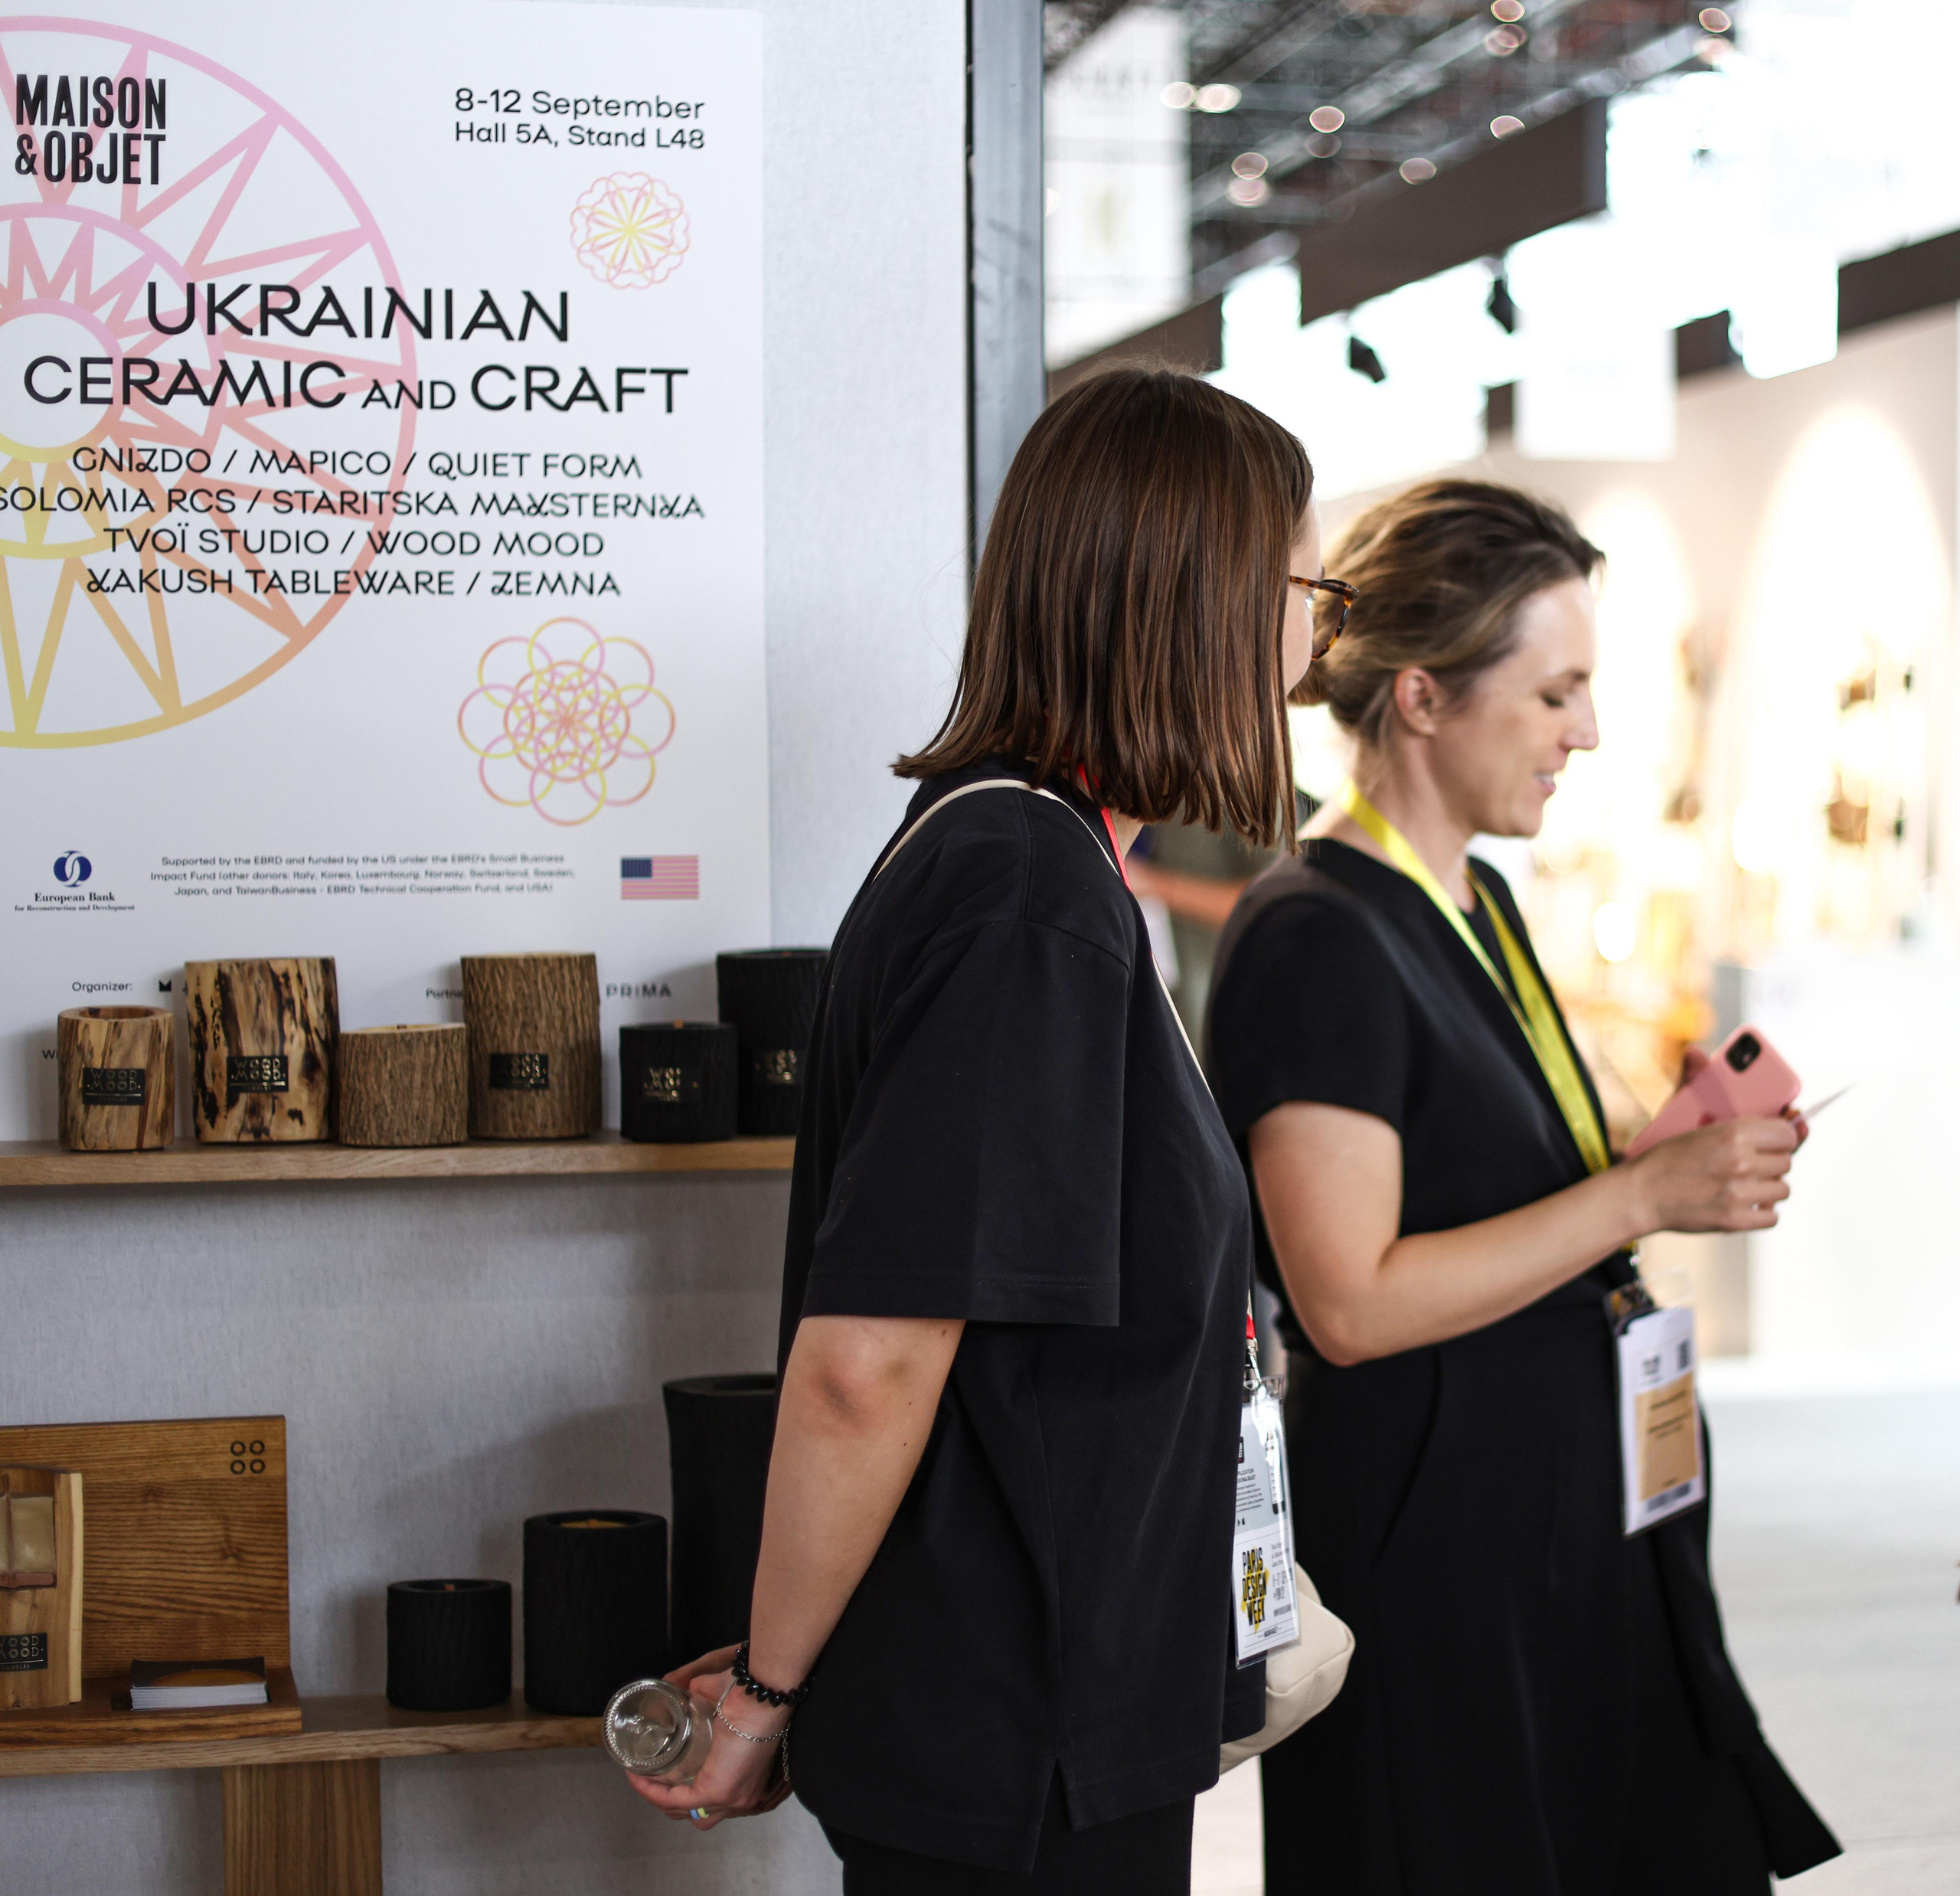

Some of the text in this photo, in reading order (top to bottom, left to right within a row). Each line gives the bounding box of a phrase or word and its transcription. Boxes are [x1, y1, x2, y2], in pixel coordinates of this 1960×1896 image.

[16, 74, 166, 129] MAISON
[455, 87, 705, 119] 8-12 September
[456, 121, 705, 149] Hall 5A, Stand L48
[148, 281, 568, 342] UKRAINIAN
[24, 355, 689, 414] CERAMIC AND CRAFT
[72, 446, 211, 474] GNIZDO
[249, 449, 391, 476] MAPICO
[428, 453, 531, 480] QUIET
[543, 453, 643, 479] FORM
[0, 486, 155, 513] SOLOMIA
[167, 489, 236, 515] RCS
[273, 490, 458, 516] STARITSKA
[103, 522, 189, 554] TVOÏ
[198, 529, 329, 555] STUDIO
[366, 531, 481, 556] WOOD
[492, 532, 605, 557] MOOD
[244, 570, 455, 596] TABLEWARE
[490, 572, 622, 597] ZEMNA
[162, 856, 216, 868] Supported
[218, 857, 231, 868] by
[234, 856, 251, 866] the
[253, 856, 283, 866] EBRD
[286, 856, 305, 865] and
[308, 855, 345, 865] funded
[347, 856, 359, 867] by
[361, 855, 378, 865] the
[399, 855, 429, 865] under
[431, 855, 449, 864] the
[488, 854, 518, 863] Small
[520, 854, 565, 863] Business
[150, 871, 188, 883] Impact
[190, 871, 217, 881] Fund
[174, 886, 210, 897] Japan,
[211, 886, 233, 896] and
[326, 885, 356, 894] EBRD
[359, 884, 407, 894] Technical
[409, 884, 472, 894] Cooperation
[505, 883, 524, 892] and
[34, 891, 115, 904] European Bank
[92, 904, 136, 913] Development
[71, 982, 133, 993] Organizer:
[606, 982, 671, 999] PRIMA
[90, 1069, 138, 1080] WOOD
[235, 1058, 281, 1070] WOOD
[90, 1080, 138, 1091] MOOD
[1242, 1546, 1263, 1576] PARIS
[1242, 1571, 1267, 1602] DESIGN
[1246, 1597, 1266, 1626] WEEK
